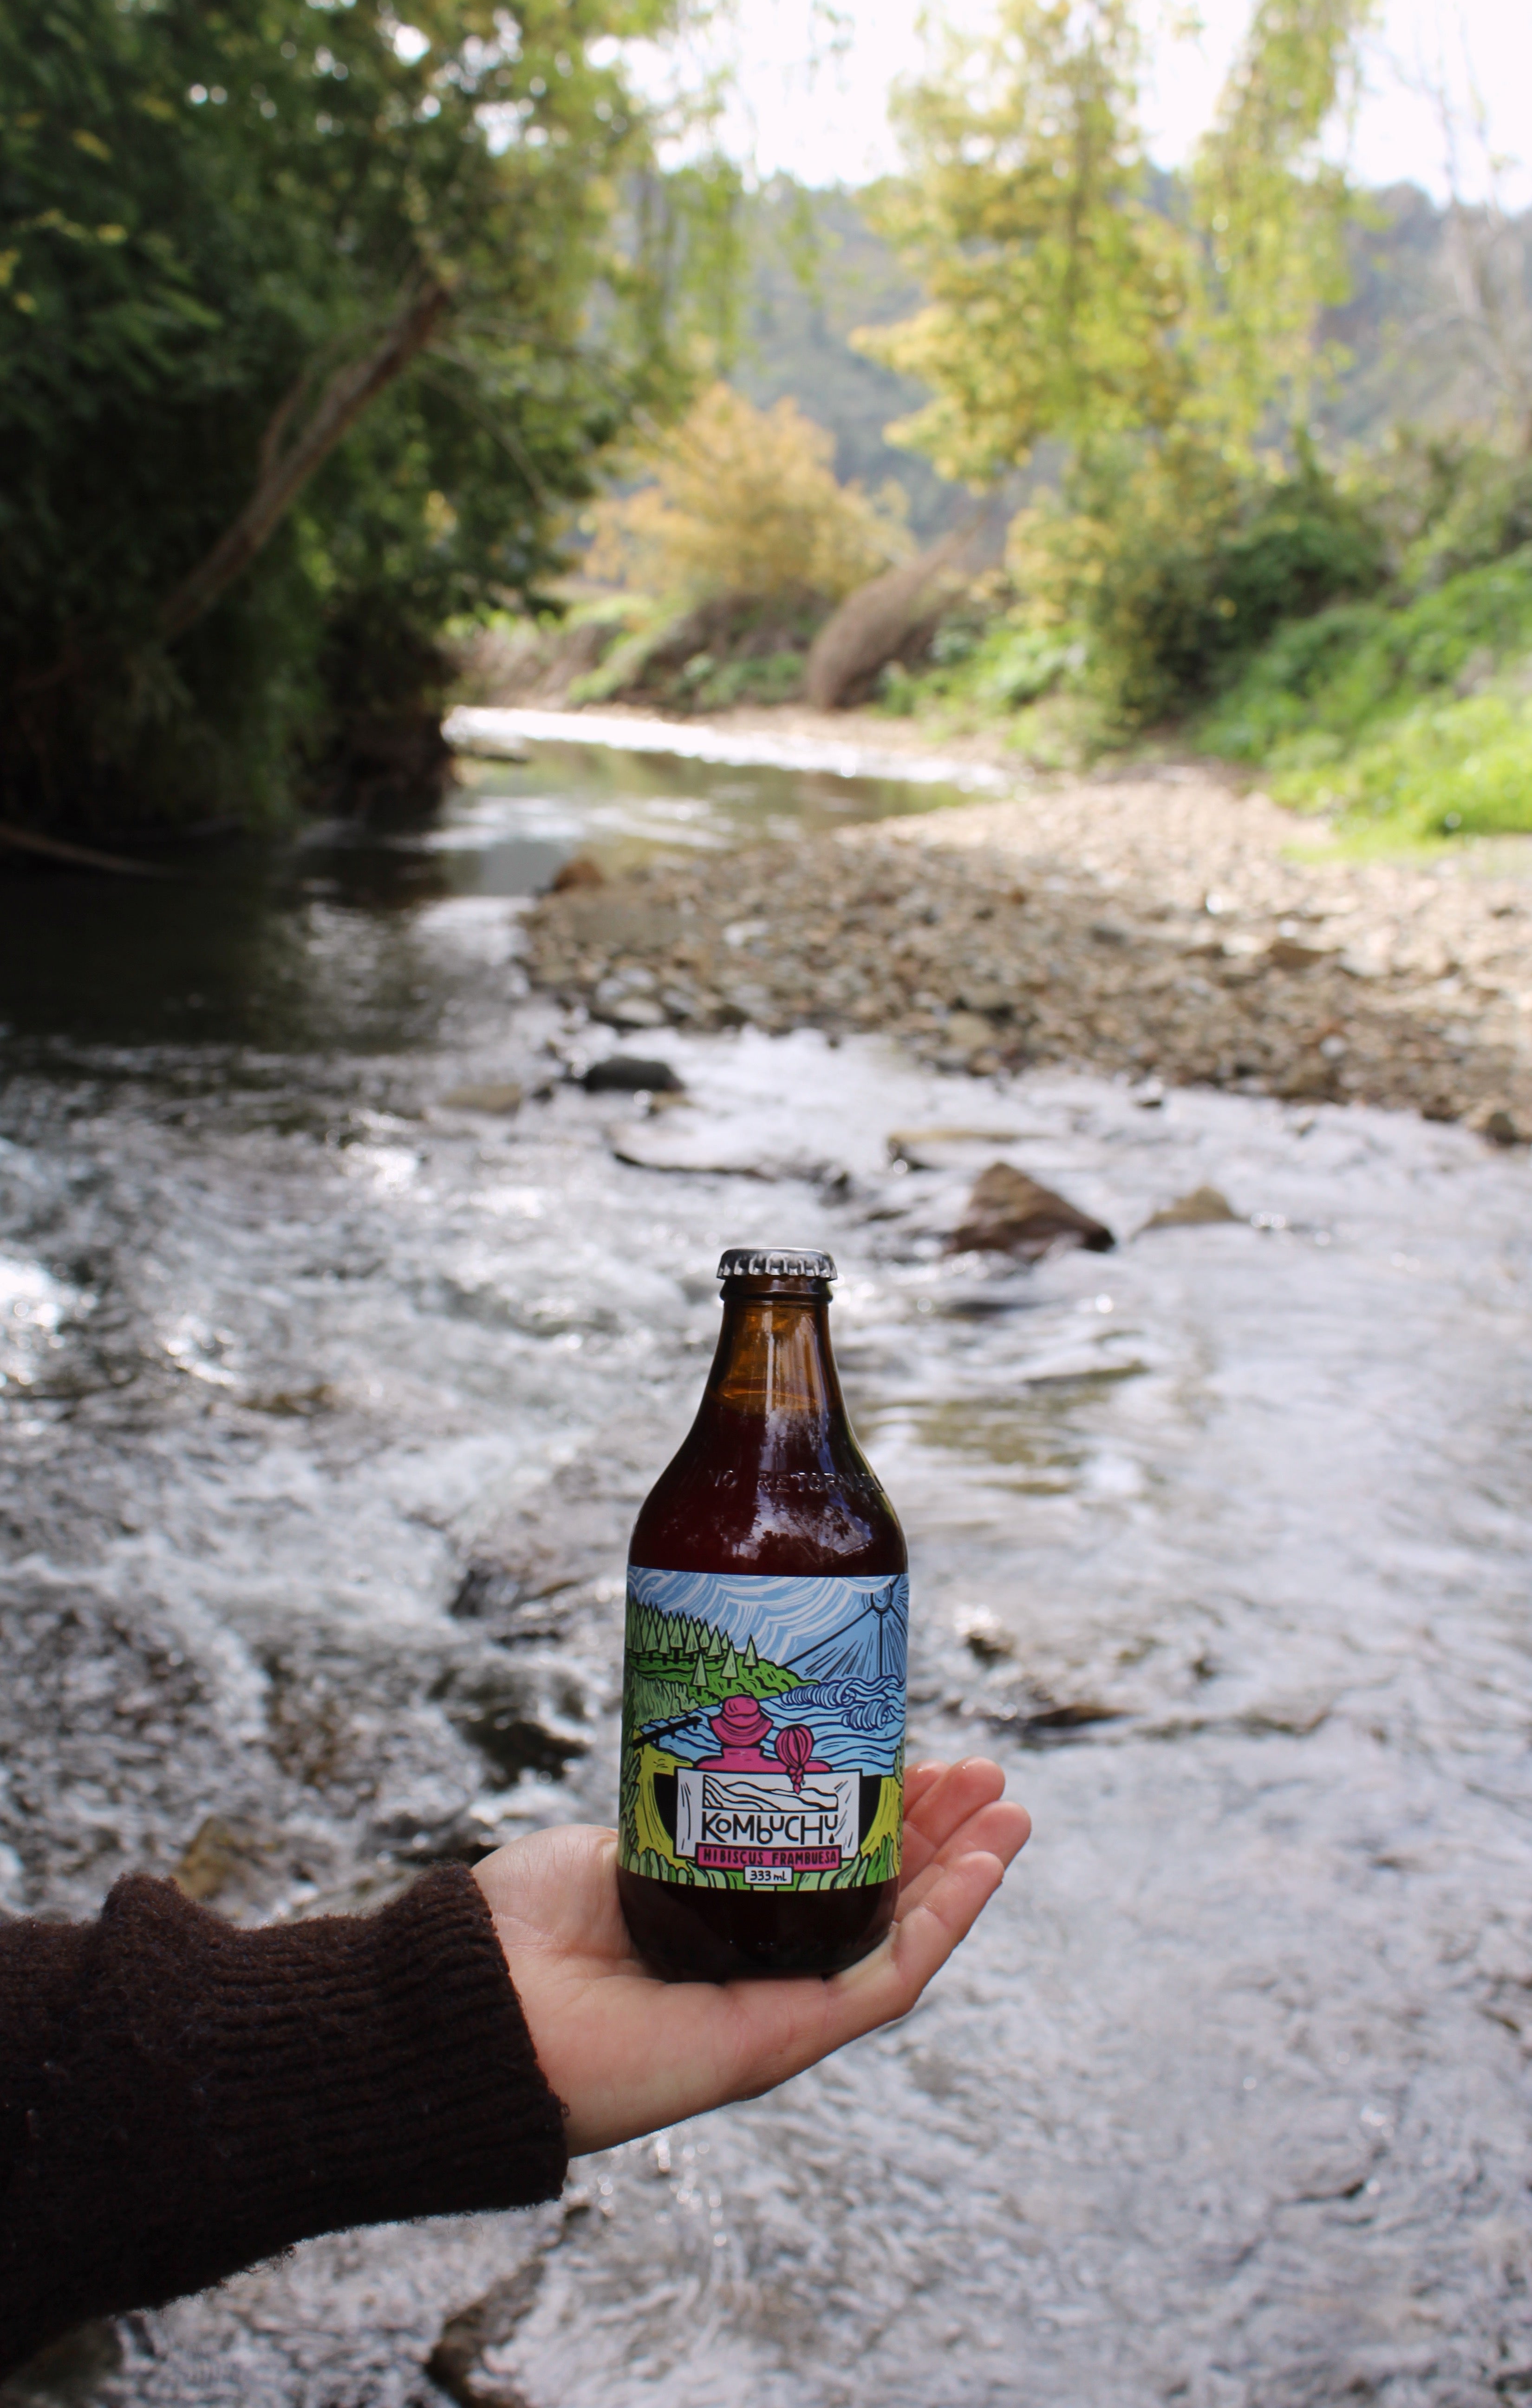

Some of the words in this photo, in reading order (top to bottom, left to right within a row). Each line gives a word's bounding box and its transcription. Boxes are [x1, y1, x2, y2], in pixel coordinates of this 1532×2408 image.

[704, 1849, 764, 1865] HIBISCUS
[772, 1851, 836, 1865] FRAMBUESA
[750, 1870, 771, 1881] 333
